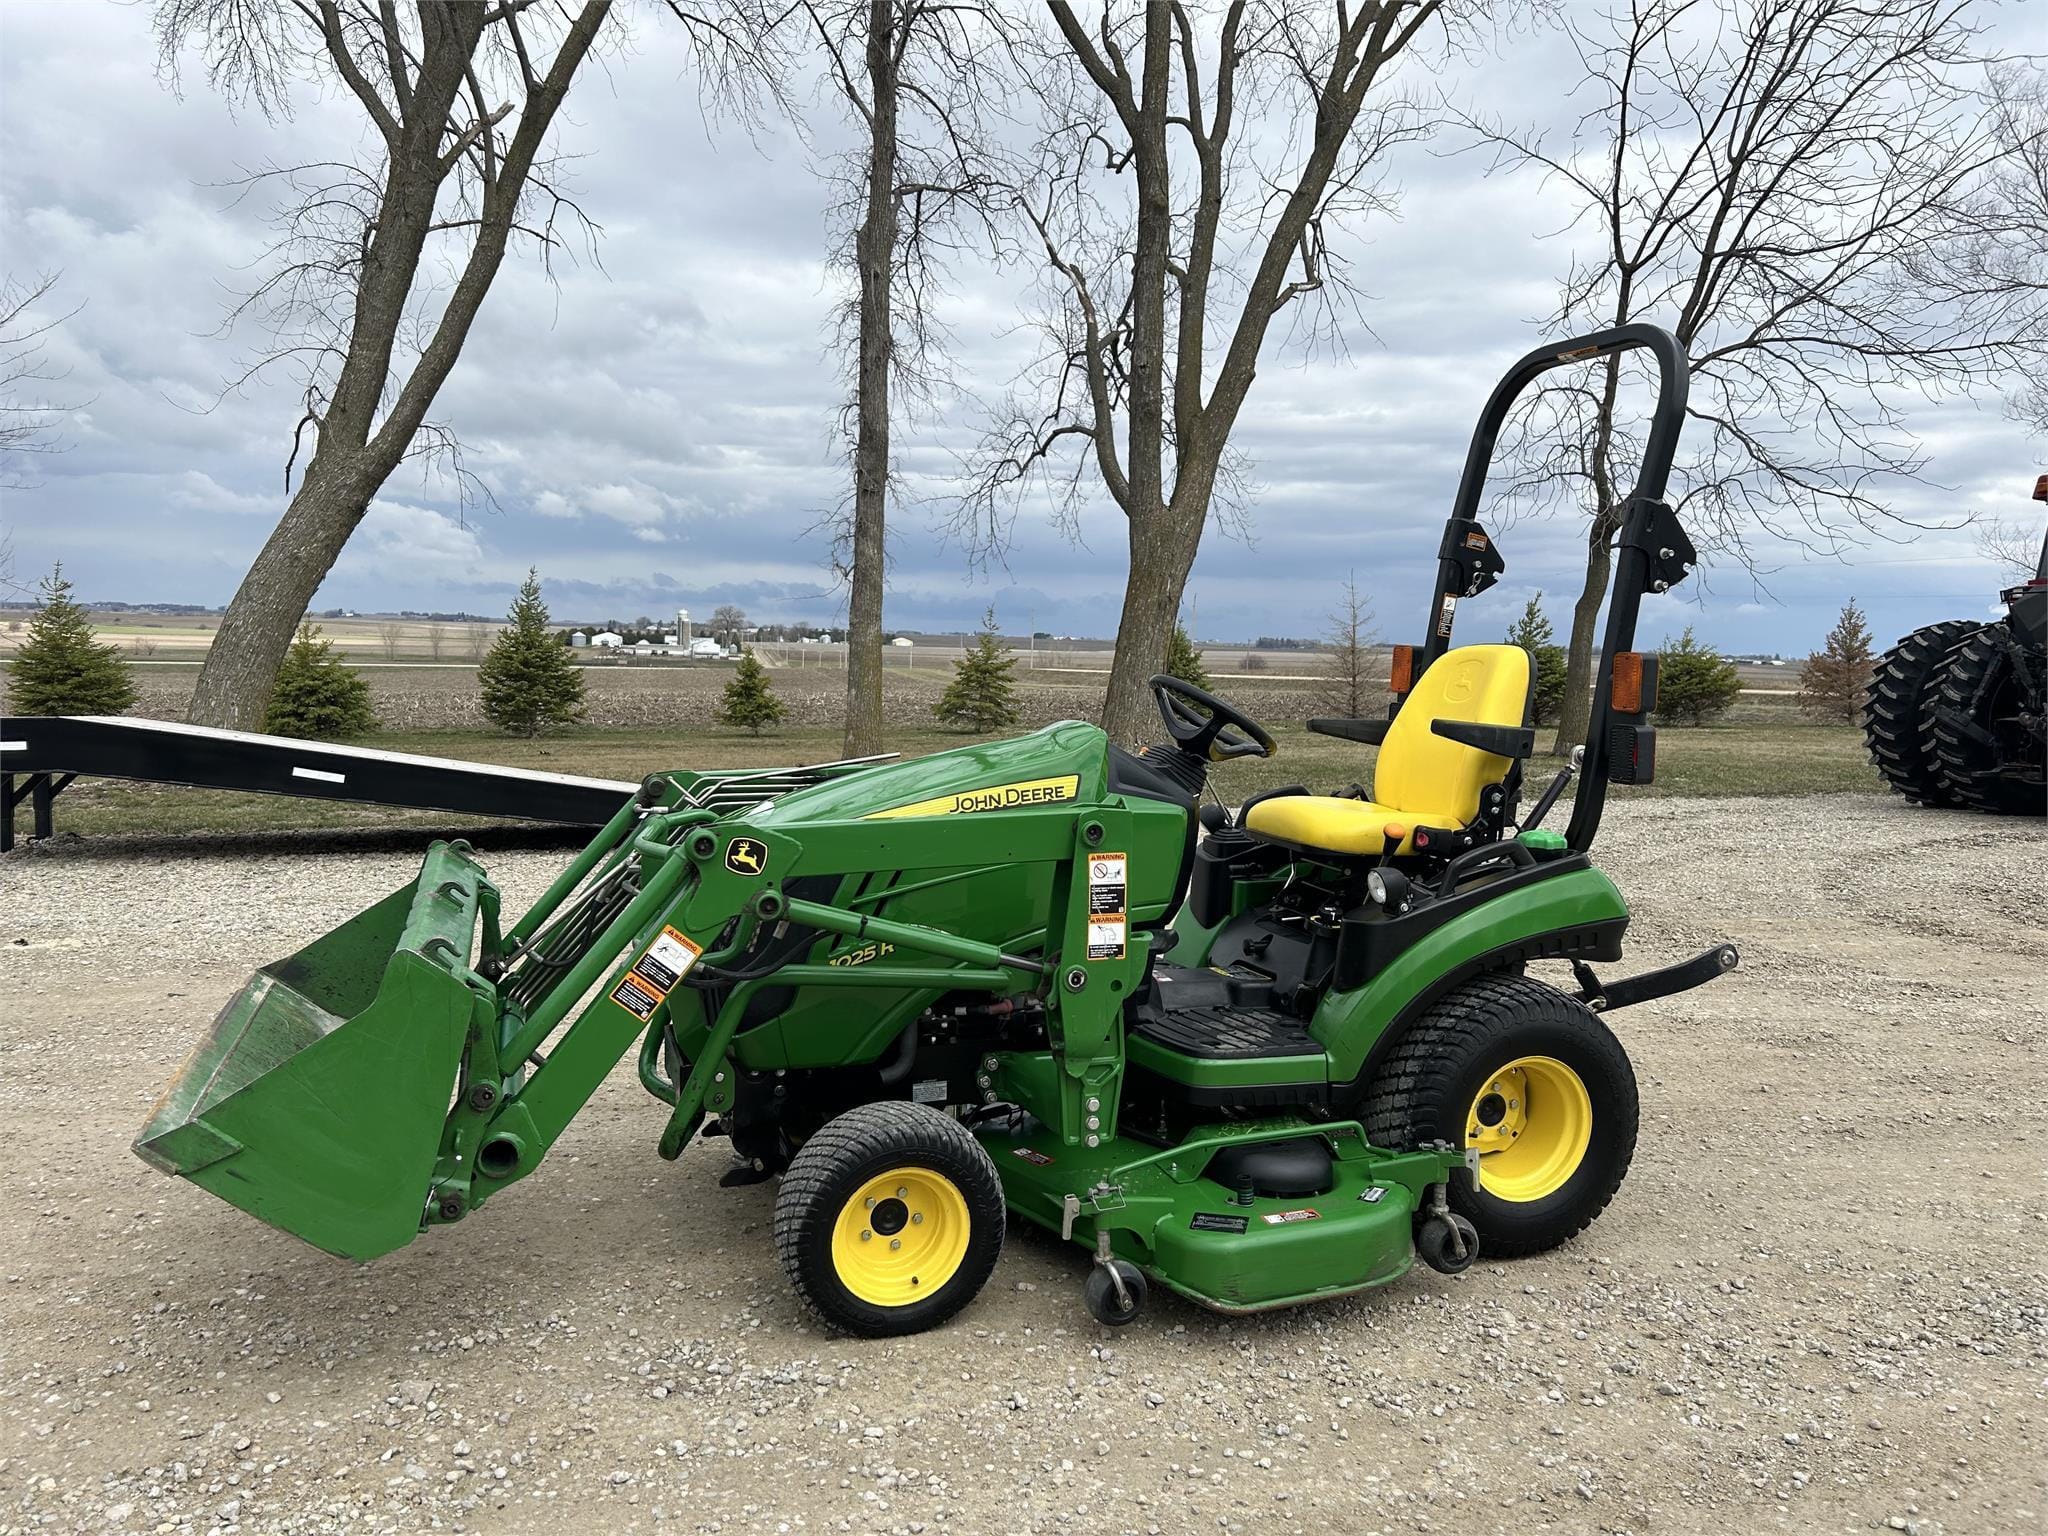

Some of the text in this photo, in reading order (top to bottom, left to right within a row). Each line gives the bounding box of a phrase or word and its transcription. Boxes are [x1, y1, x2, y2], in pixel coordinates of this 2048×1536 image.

[950, 786, 1066, 813] JOHN DEERE
[1096, 853, 1125, 861] WARNING
[1096, 916, 1125, 924] WARNING
[674, 932, 698, 952] WARNING
[636, 980, 660, 1000] WARNING
